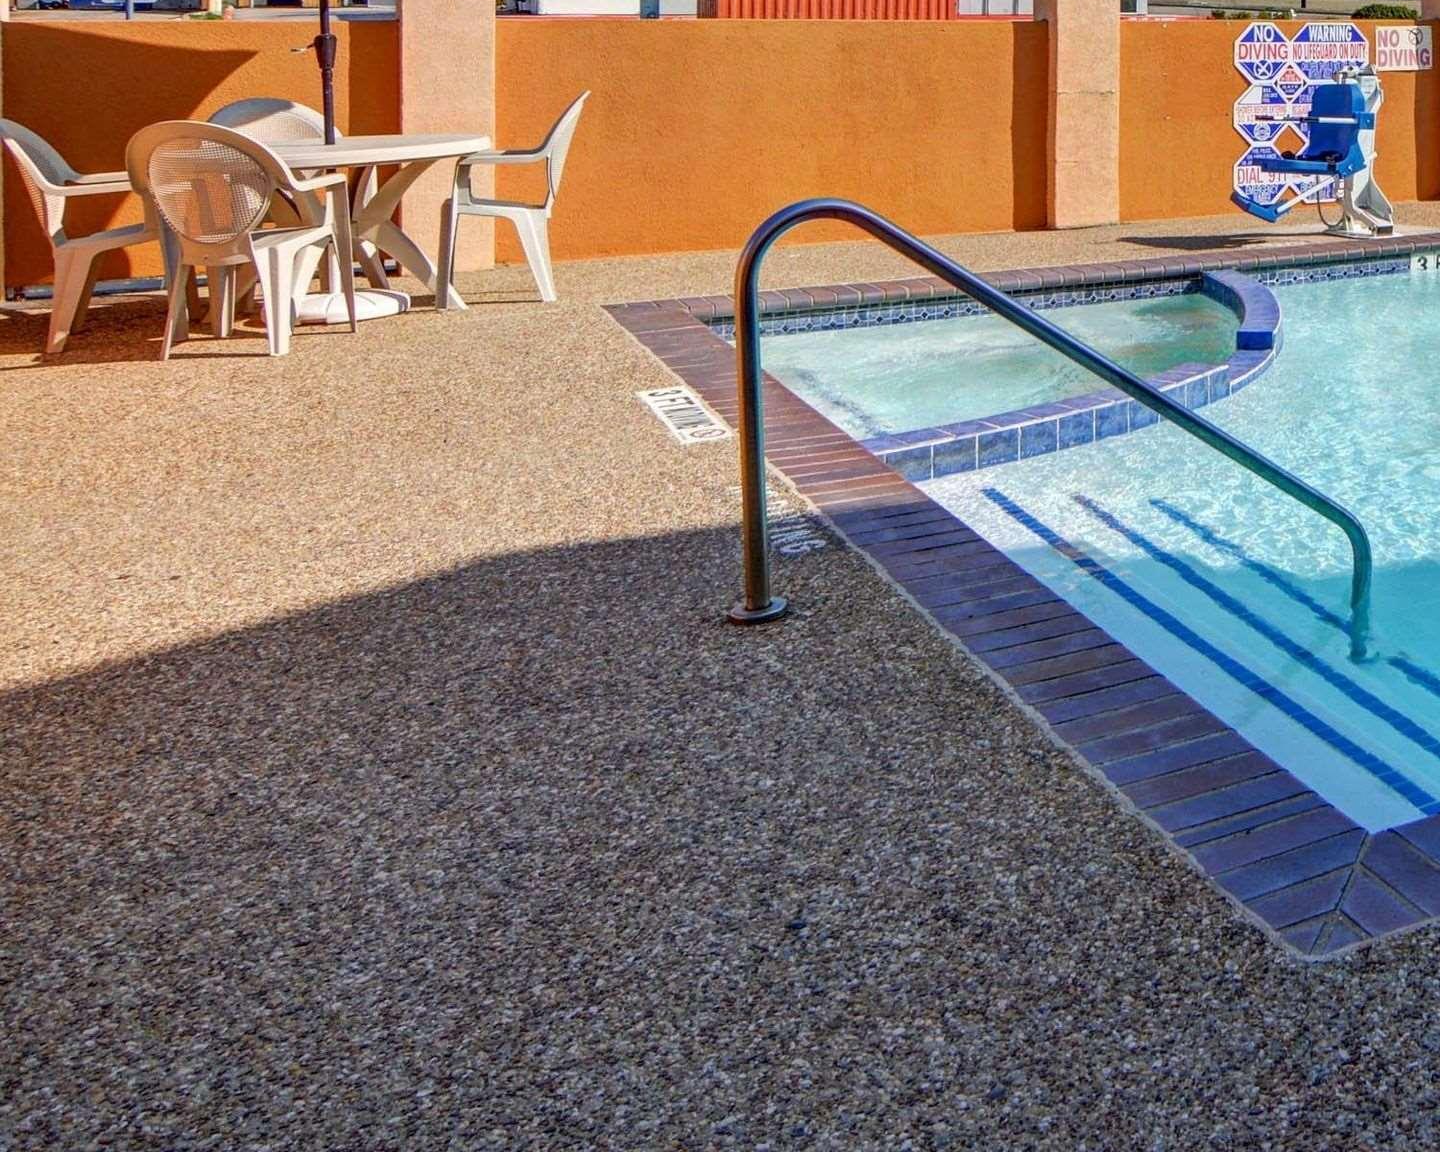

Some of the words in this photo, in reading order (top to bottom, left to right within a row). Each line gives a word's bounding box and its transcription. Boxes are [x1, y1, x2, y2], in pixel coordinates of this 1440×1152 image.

[1253, 24, 1275, 42] NO
[1308, 25, 1352, 42] WARNING
[1378, 30, 1400, 48] NO
[1239, 43, 1288, 60] DIVING
[1293, 43, 1302, 60] NO
[1304, 43, 1337, 60] LIFEGUARD
[1339, 43, 1348, 60] ON
[1350, 43, 1366, 60] DUTY
[1378, 48, 1431, 67] DIVING
[1238, 168, 1263, 184] DIAL
[1417, 255, 1429, 271] 3
